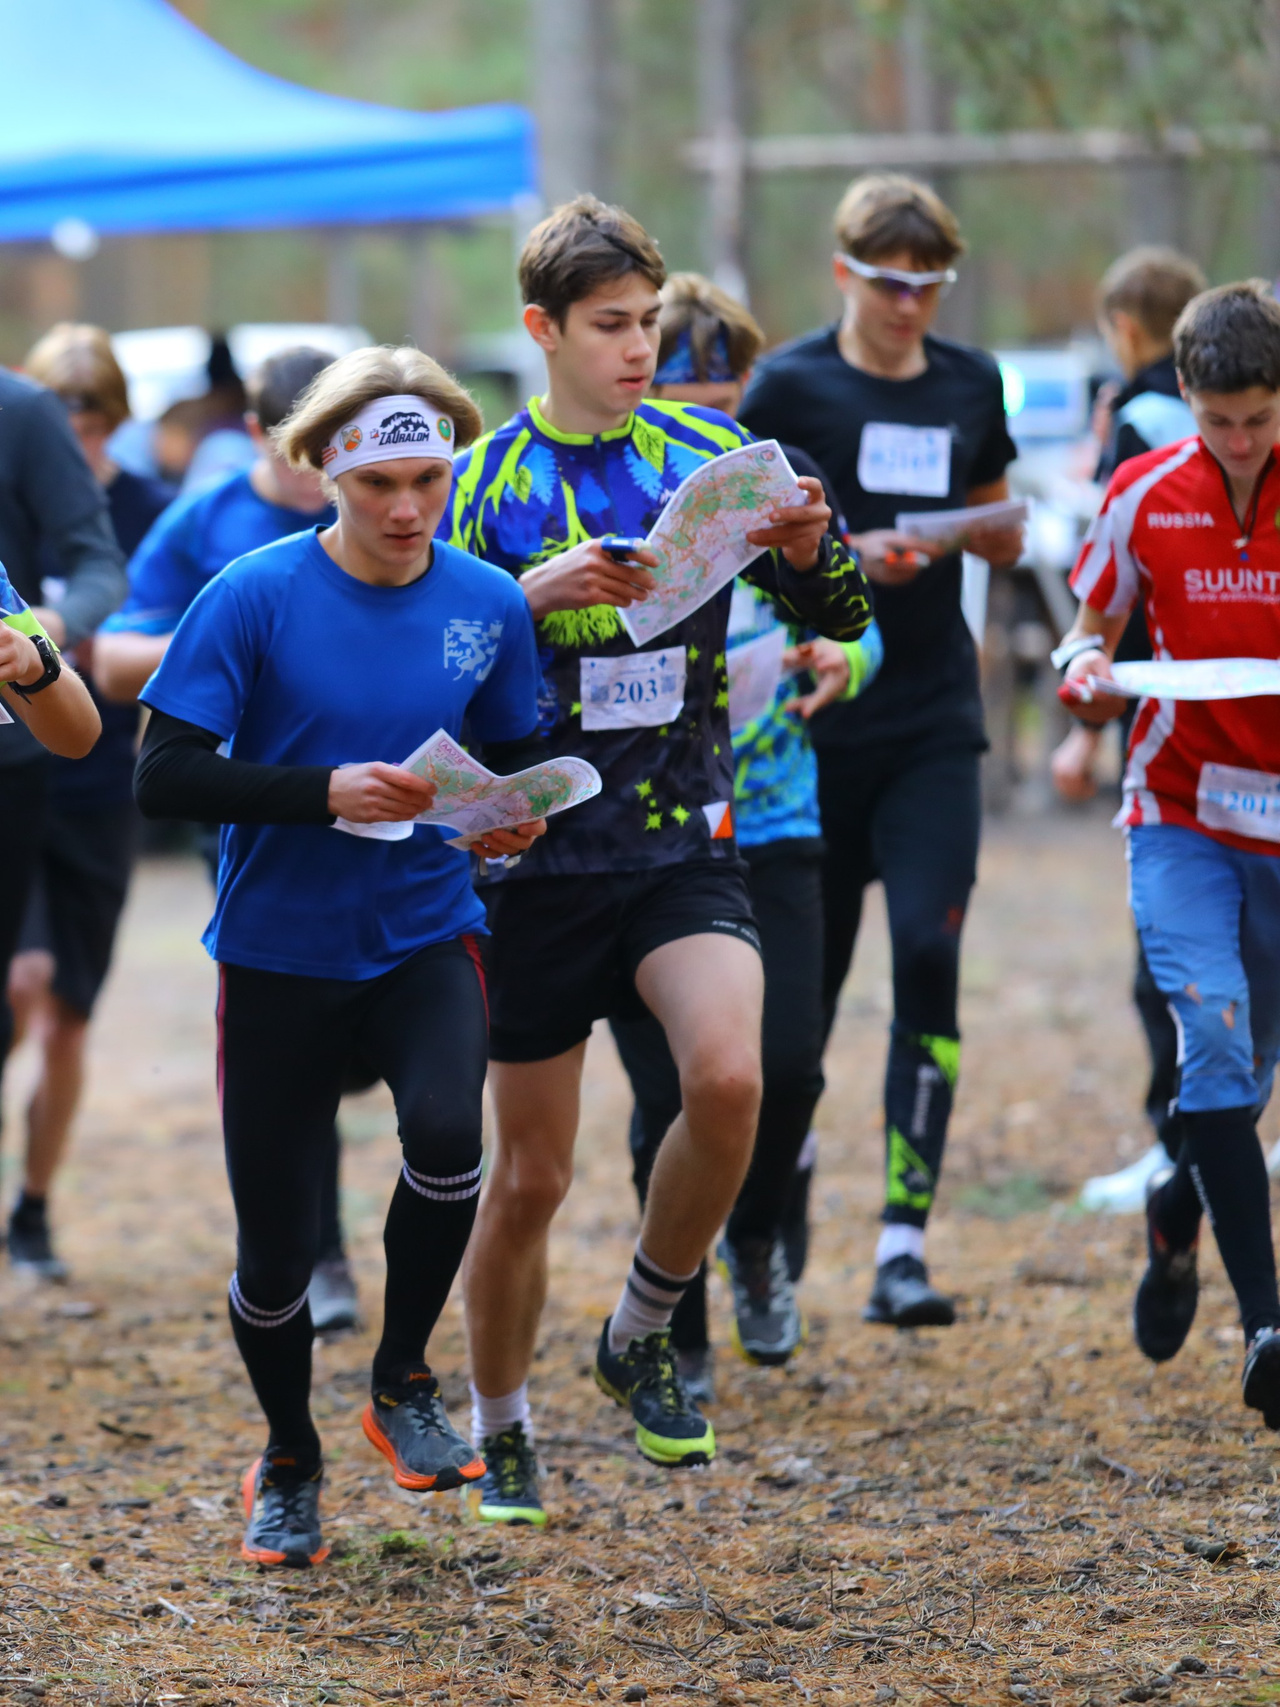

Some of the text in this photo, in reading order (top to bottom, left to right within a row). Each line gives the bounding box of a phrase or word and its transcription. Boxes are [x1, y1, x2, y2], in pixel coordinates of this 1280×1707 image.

[378, 430, 431, 446] ZAURALOM
[1146, 511, 1215, 529] RUSSIA
[613, 679, 658, 704] 203
[1227, 790, 1268, 816] 201
